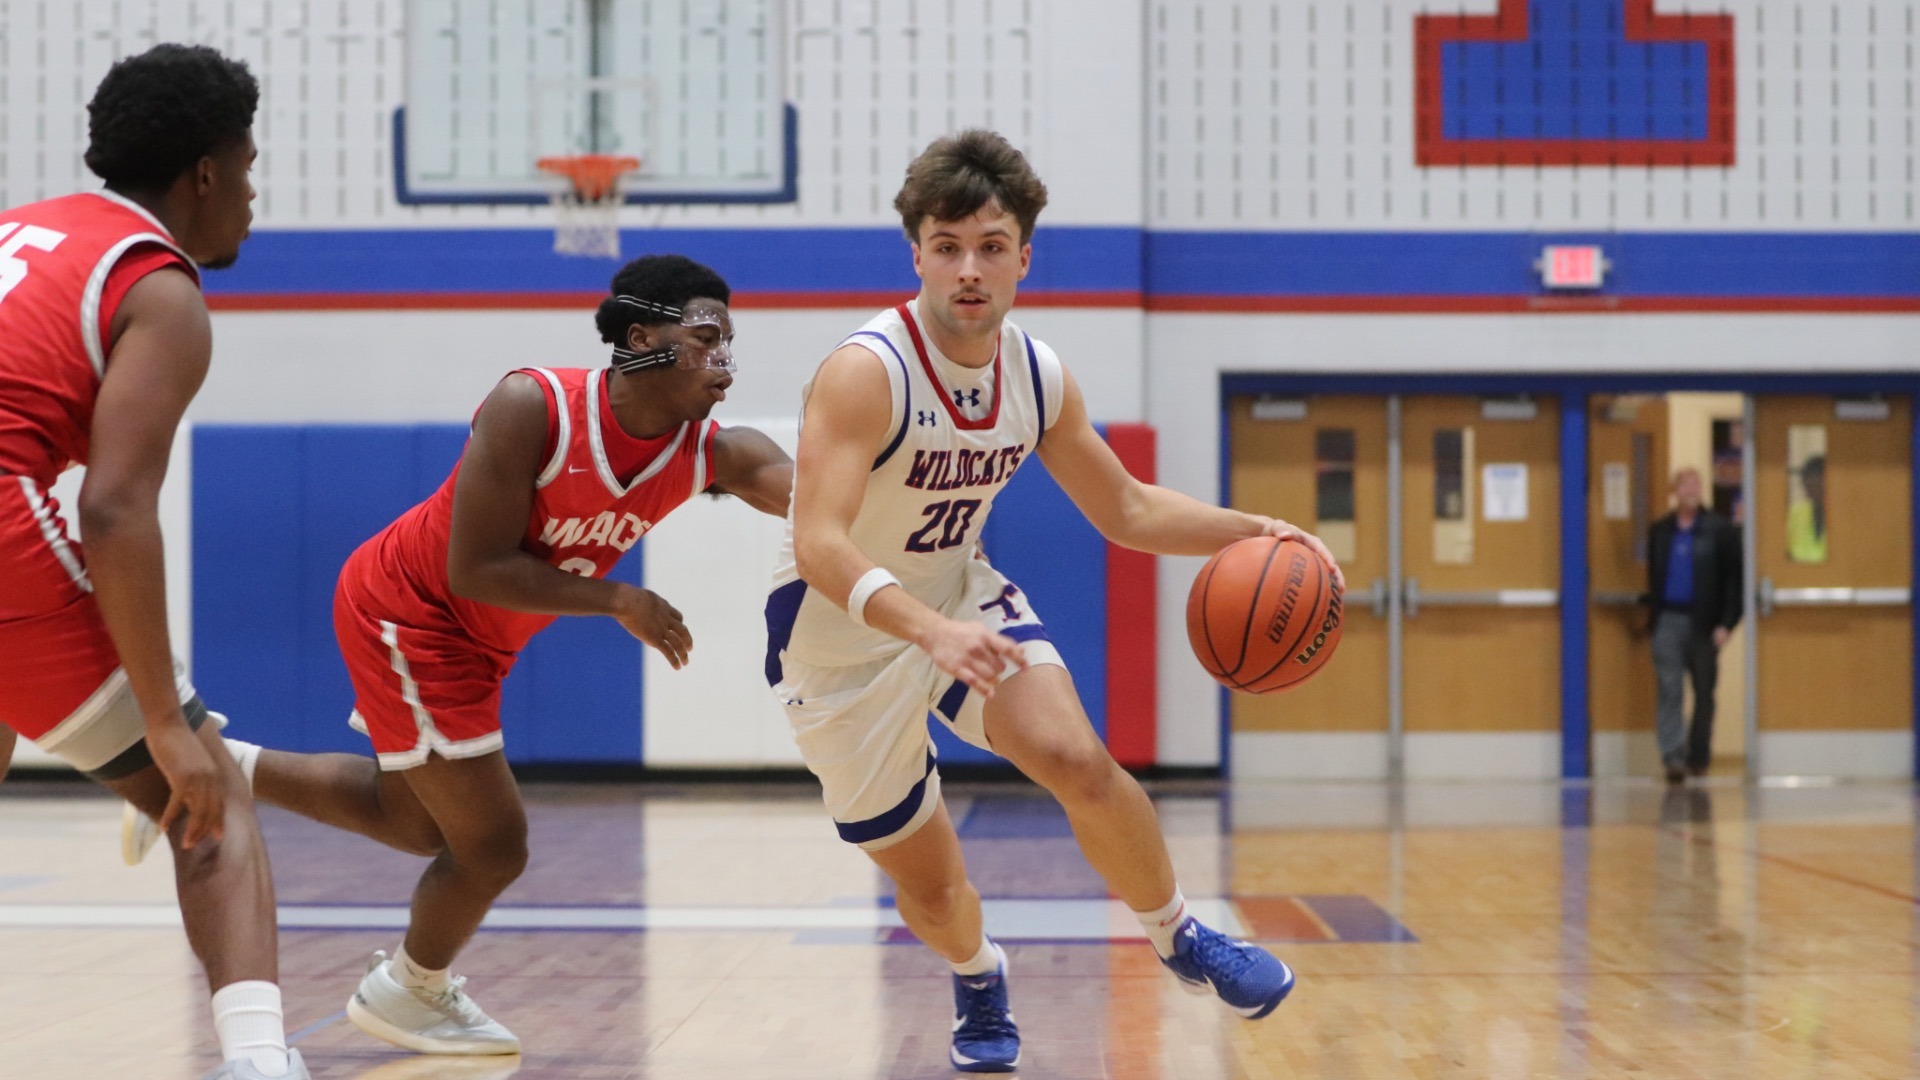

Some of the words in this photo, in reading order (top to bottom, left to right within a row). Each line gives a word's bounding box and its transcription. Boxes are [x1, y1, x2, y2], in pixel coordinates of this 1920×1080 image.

[904, 443, 1024, 491] WILDCATS
[538, 510, 652, 552] WAC
[904, 499, 982, 553] 20
[1266, 552, 1307, 644] EVOLUTION
